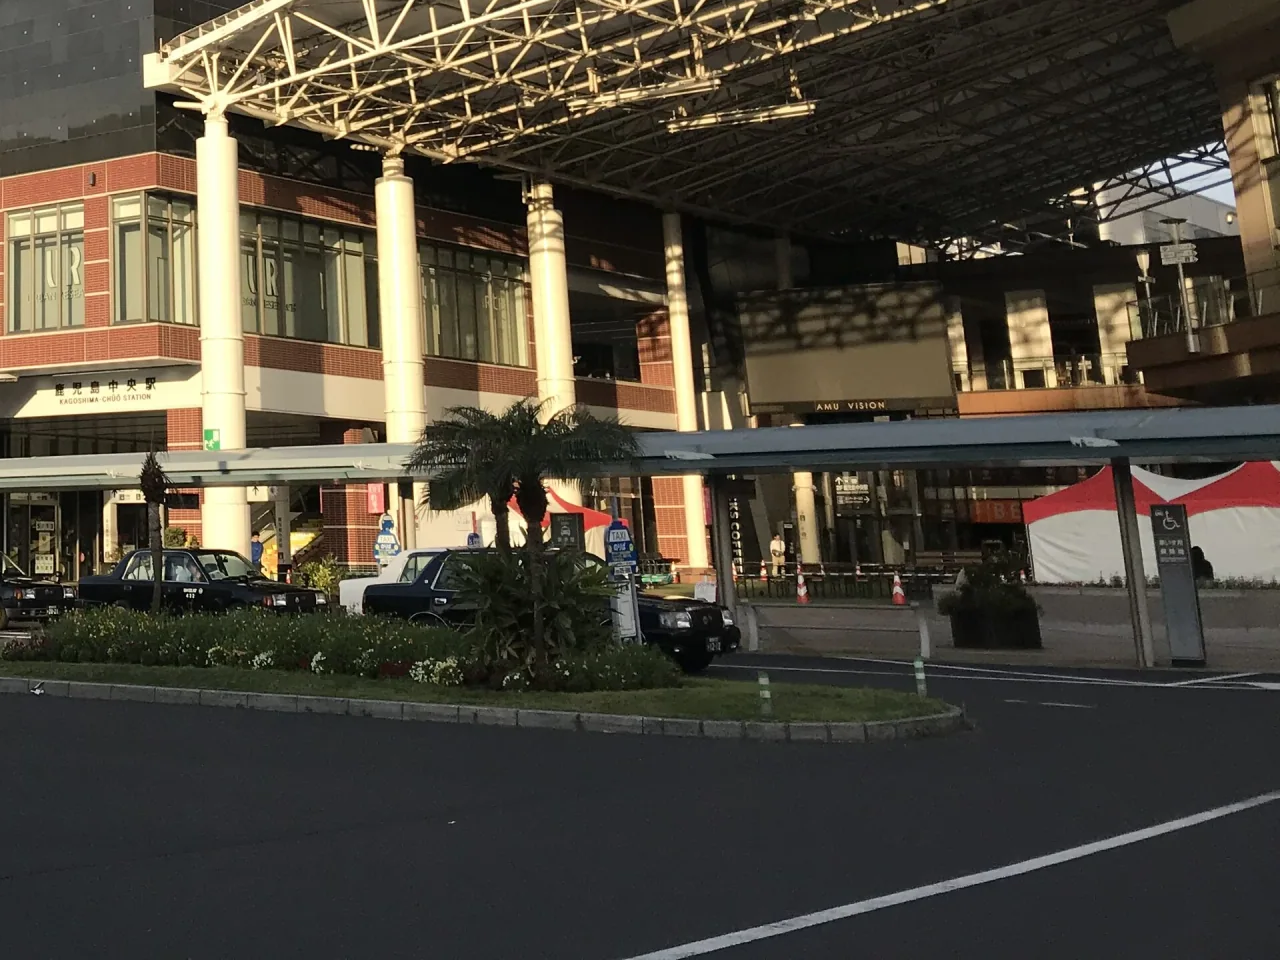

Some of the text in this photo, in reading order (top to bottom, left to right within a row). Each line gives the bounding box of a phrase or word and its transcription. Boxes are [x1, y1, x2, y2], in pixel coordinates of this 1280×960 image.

[54, 376, 157, 397] 鹿児島中央駅
[123, 393, 152, 401] STATION
[816, 401, 885, 412] AMU VISION
[612, 531, 627, 541] TAXI
[731, 522, 744, 574] COFFEE
